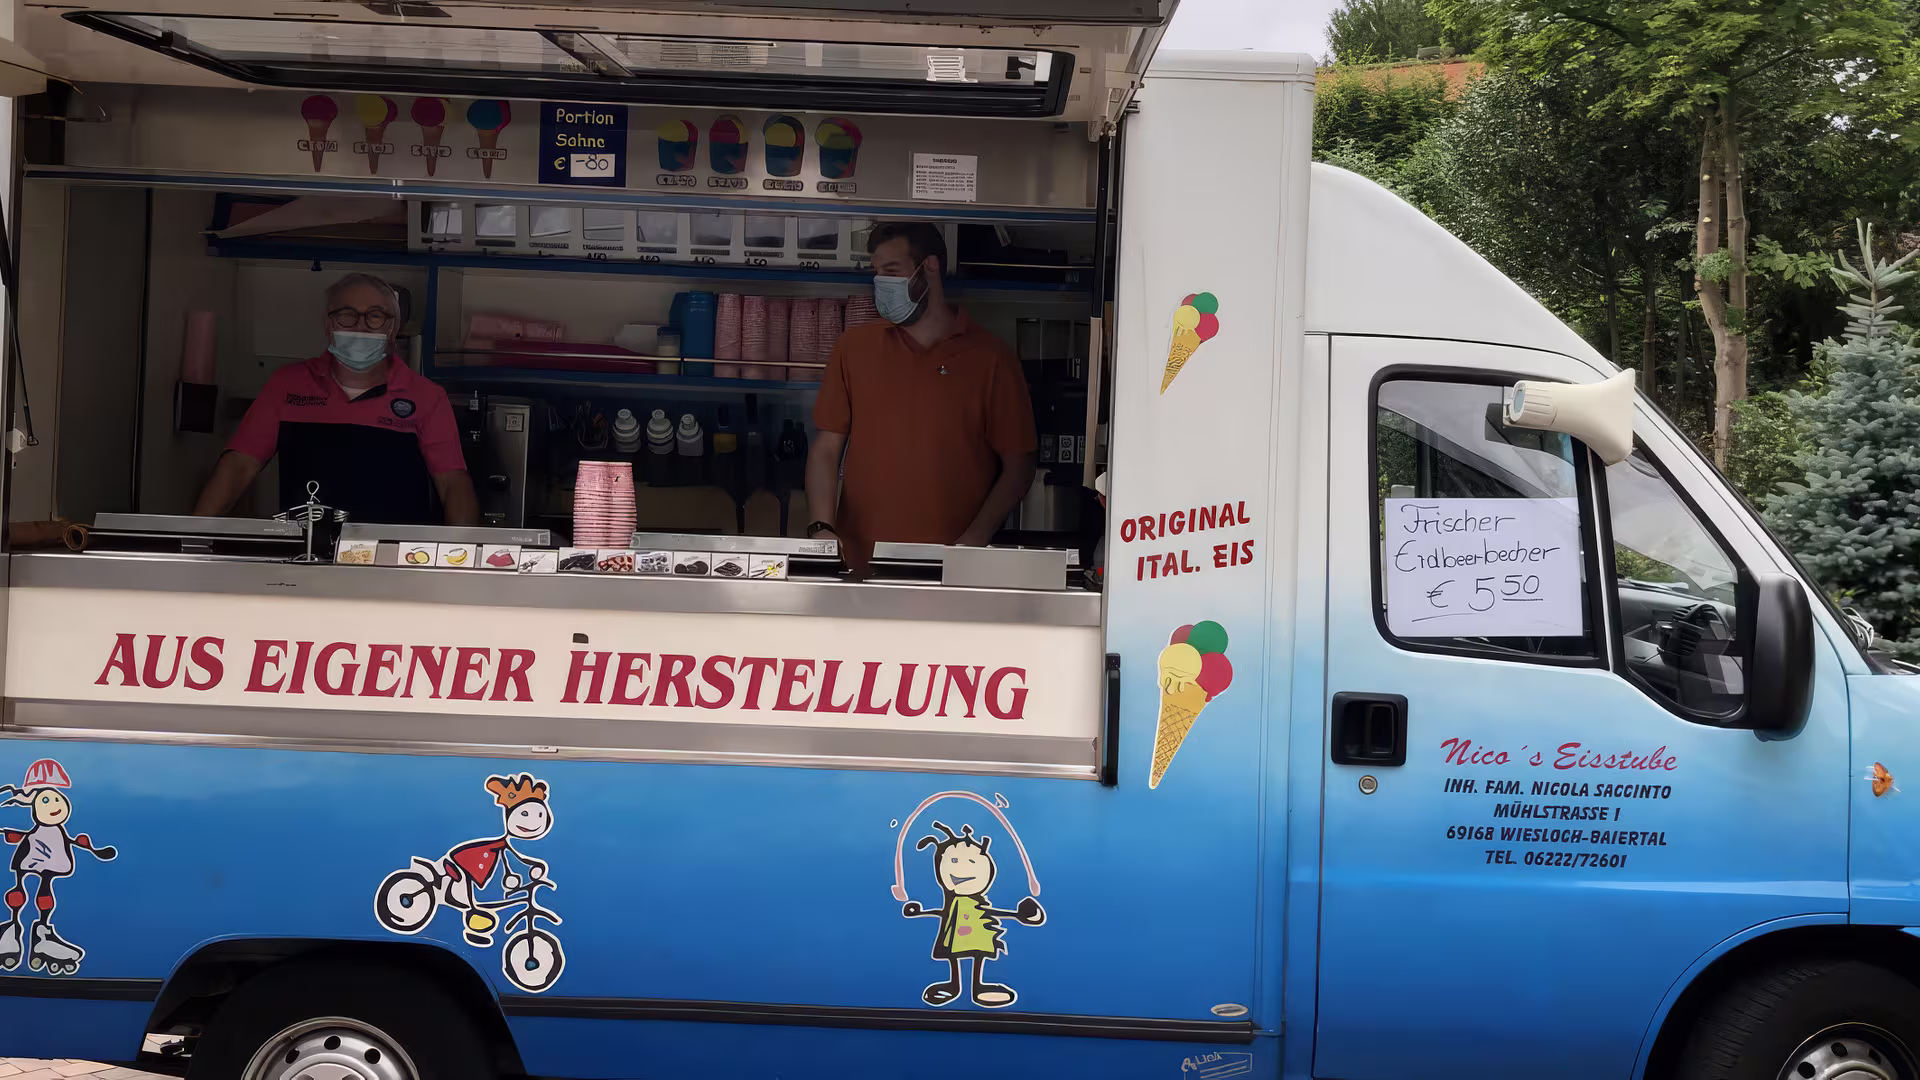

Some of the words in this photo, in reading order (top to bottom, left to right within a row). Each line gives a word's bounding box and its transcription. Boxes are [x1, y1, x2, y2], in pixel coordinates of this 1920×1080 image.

[556, 108, 614, 125] Portion
[555, 133, 605, 148] Sahne
[1120, 500, 1251, 543] ORIGINAL
[1400, 504, 1516, 535] Frischer
[1136, 549, 1201, 582] ITAL.
[1212, 539, 1255, 569] EIS
[94, 633, 225, 691] AUS
[243, 639, 537, 703] EIGENER
[559, 650, 1029, 721] HERSTELLUNG
[1553, 742, 1679, 771] Eisstube
[1444, 778, 1479, 794] INH.
[1485, 780, 1525, 796] FAM.
[1530, 781, 1590, 797] NICOLA
[1493, 801, 1610, 821] MÜHLSTRASSE
[1446, 826, 1495, 841] 69168
[1500, 827, 1668, 846] WIESLOCH-BAIERTAL
[1485, 850, 1518, 865] TEL.
[1523, 851, 1628, 869] 06222/72601
